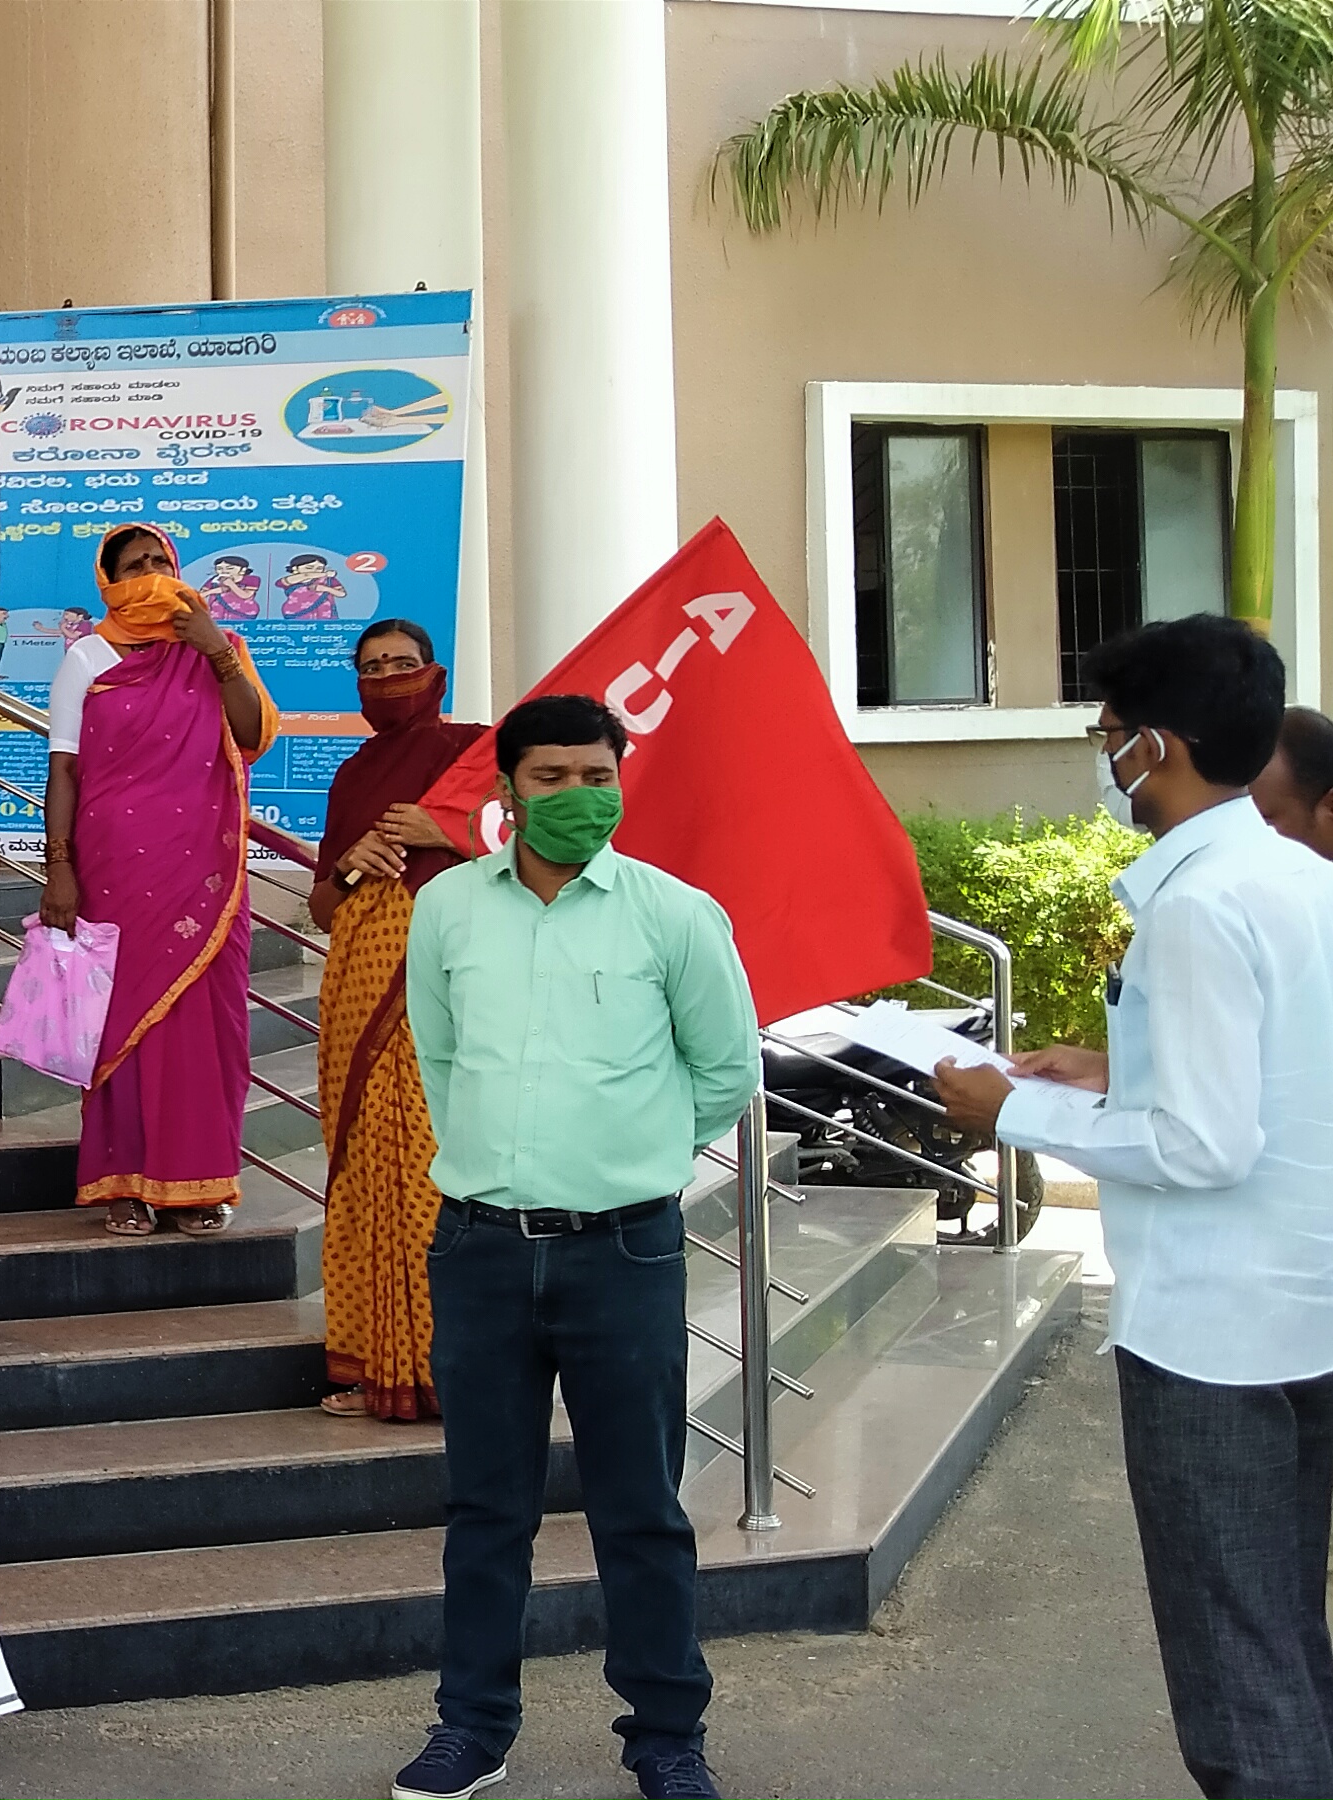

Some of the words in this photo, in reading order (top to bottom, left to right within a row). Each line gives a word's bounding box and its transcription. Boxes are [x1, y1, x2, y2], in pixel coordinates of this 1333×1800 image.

[51, 342, 112, 372] ಕಲ್ಯಾಣ
[187, 333, 277, 359] ಯಾದಗಿರಿ
[160, 427, 264, 440] COVID-19
[12, 443, 141, 463] ಕರೋನಾ
[156, 441, 253, 466] ವೈರಸ್
[84, 472, 140, 491] ಭಯ
[152, 469, 210, 486] ಬೇಡ
[354, 554, 377, 572] 2
[27, 639, 57, 647] Meter
